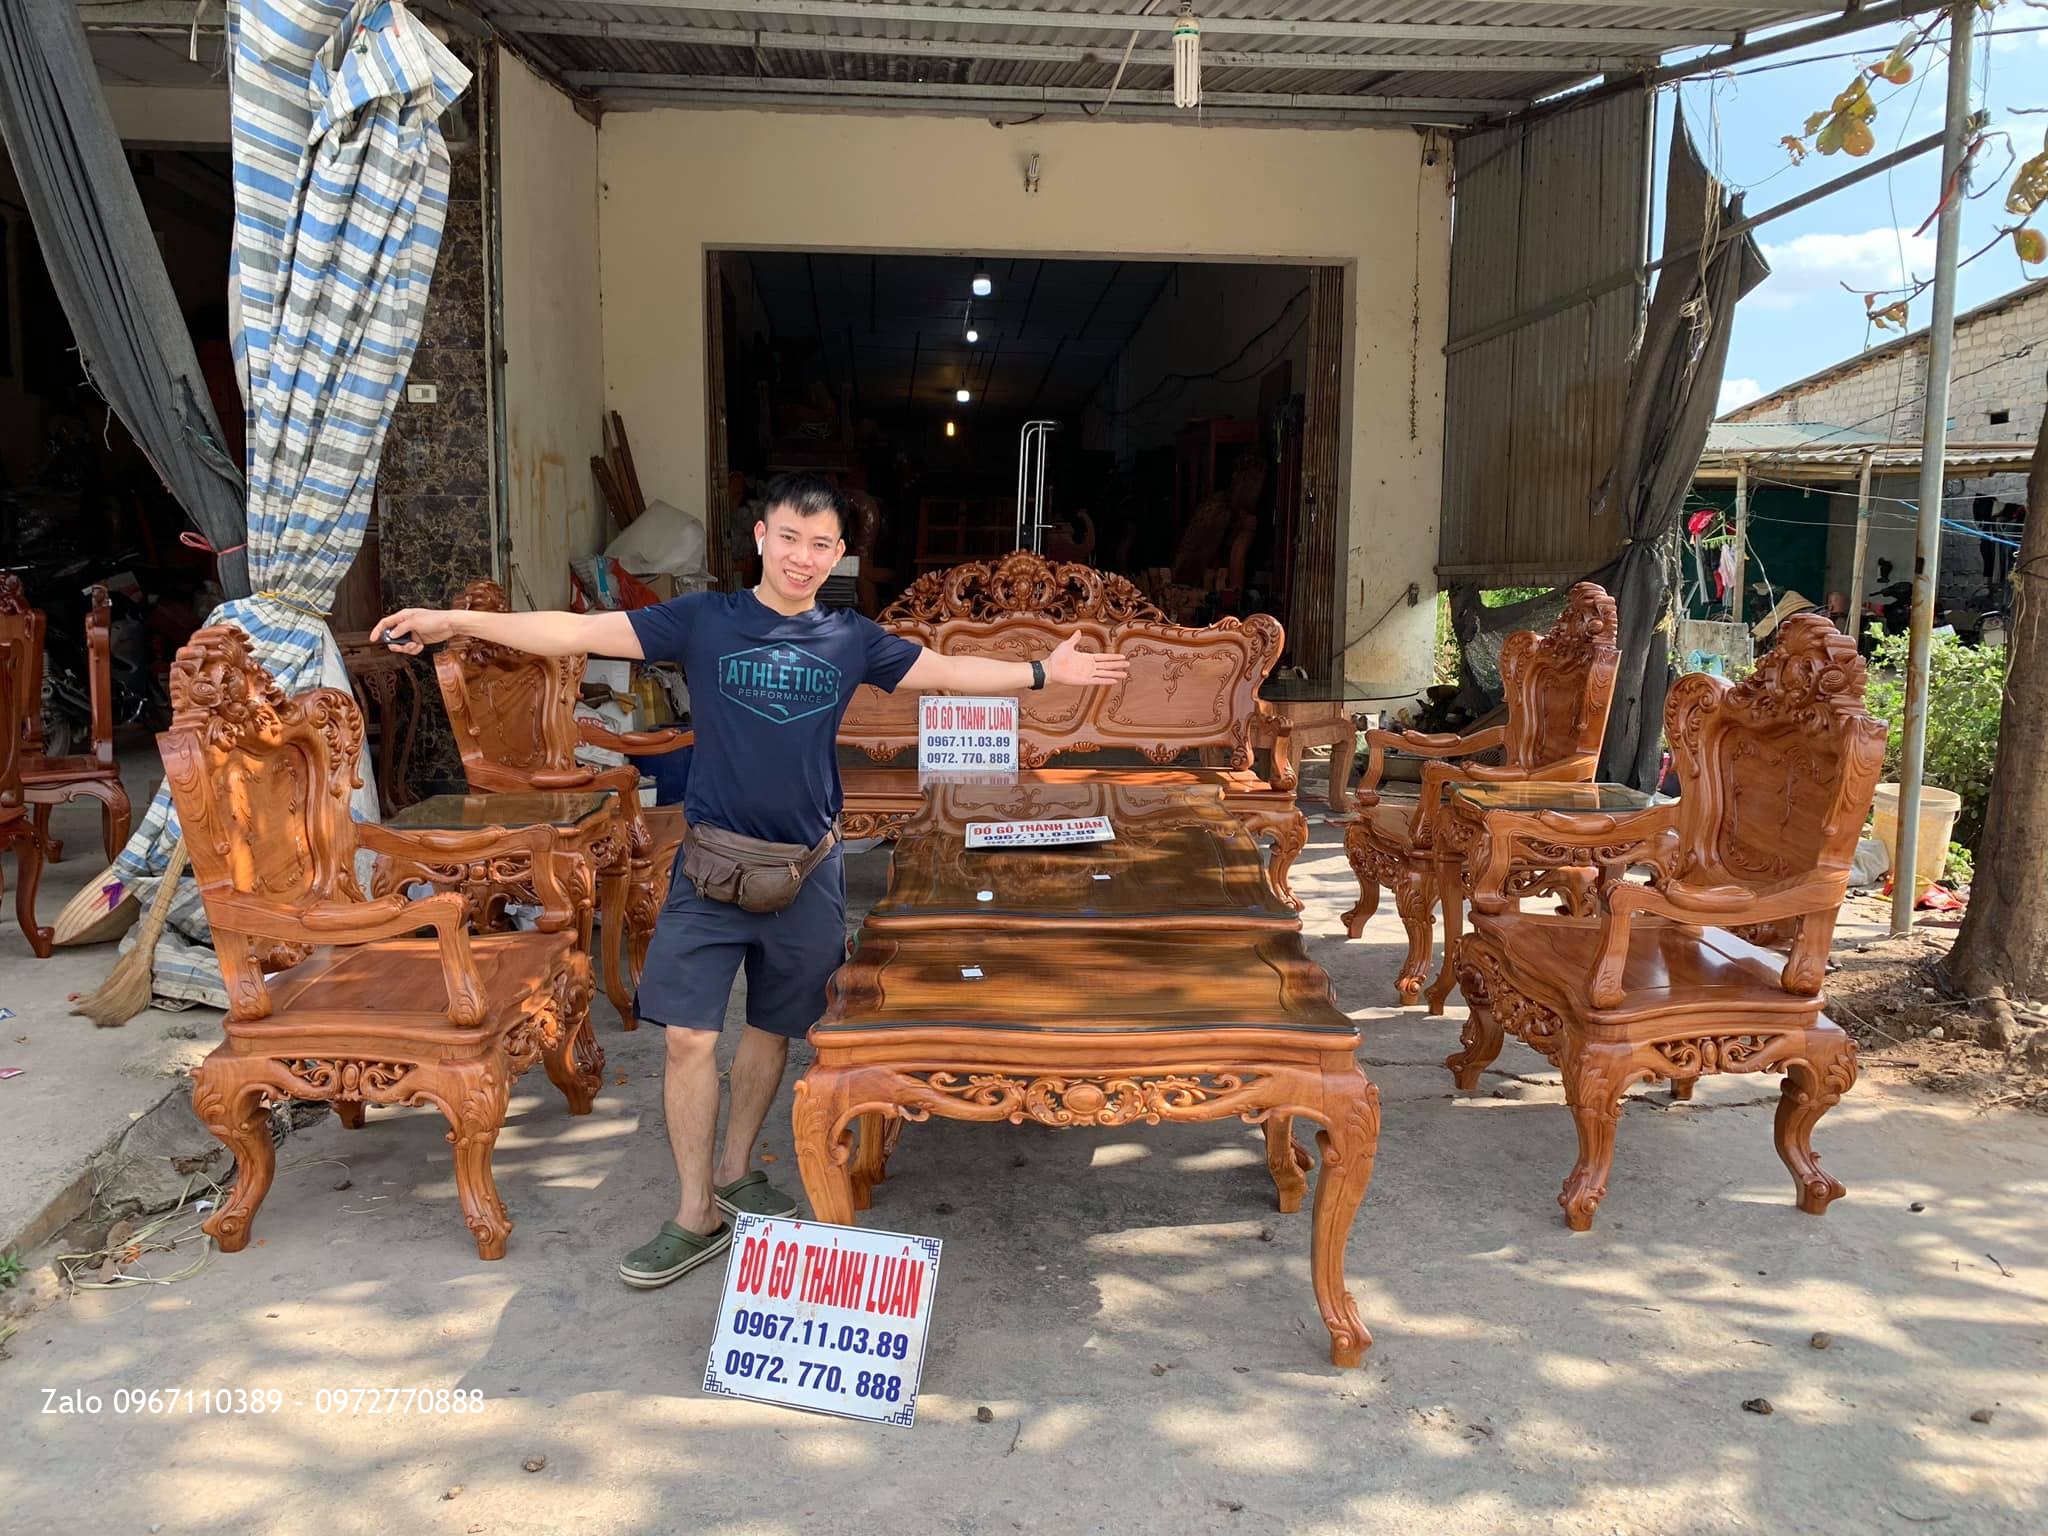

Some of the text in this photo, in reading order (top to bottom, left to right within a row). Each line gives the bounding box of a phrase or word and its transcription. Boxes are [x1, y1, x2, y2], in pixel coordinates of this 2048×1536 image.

[726, 659, 835, 694] ATHLETICS
[738, 688, 822, 703] PERFORMANCE
[927, 736, 1010, 747] 0967.11.03.89
[927, 753, 1010, 764] 0972. 770. 888
[736, 1223, 773, 1295] ĐỒ
[799, 1237, 868, 1310] THÀNH
[865, 1246, 925, 1319] LUÂN
[733, 1309, 909, 1360] 0967.11.03.89
[724, 1350, 902, 1402] 0972. 770. 888
